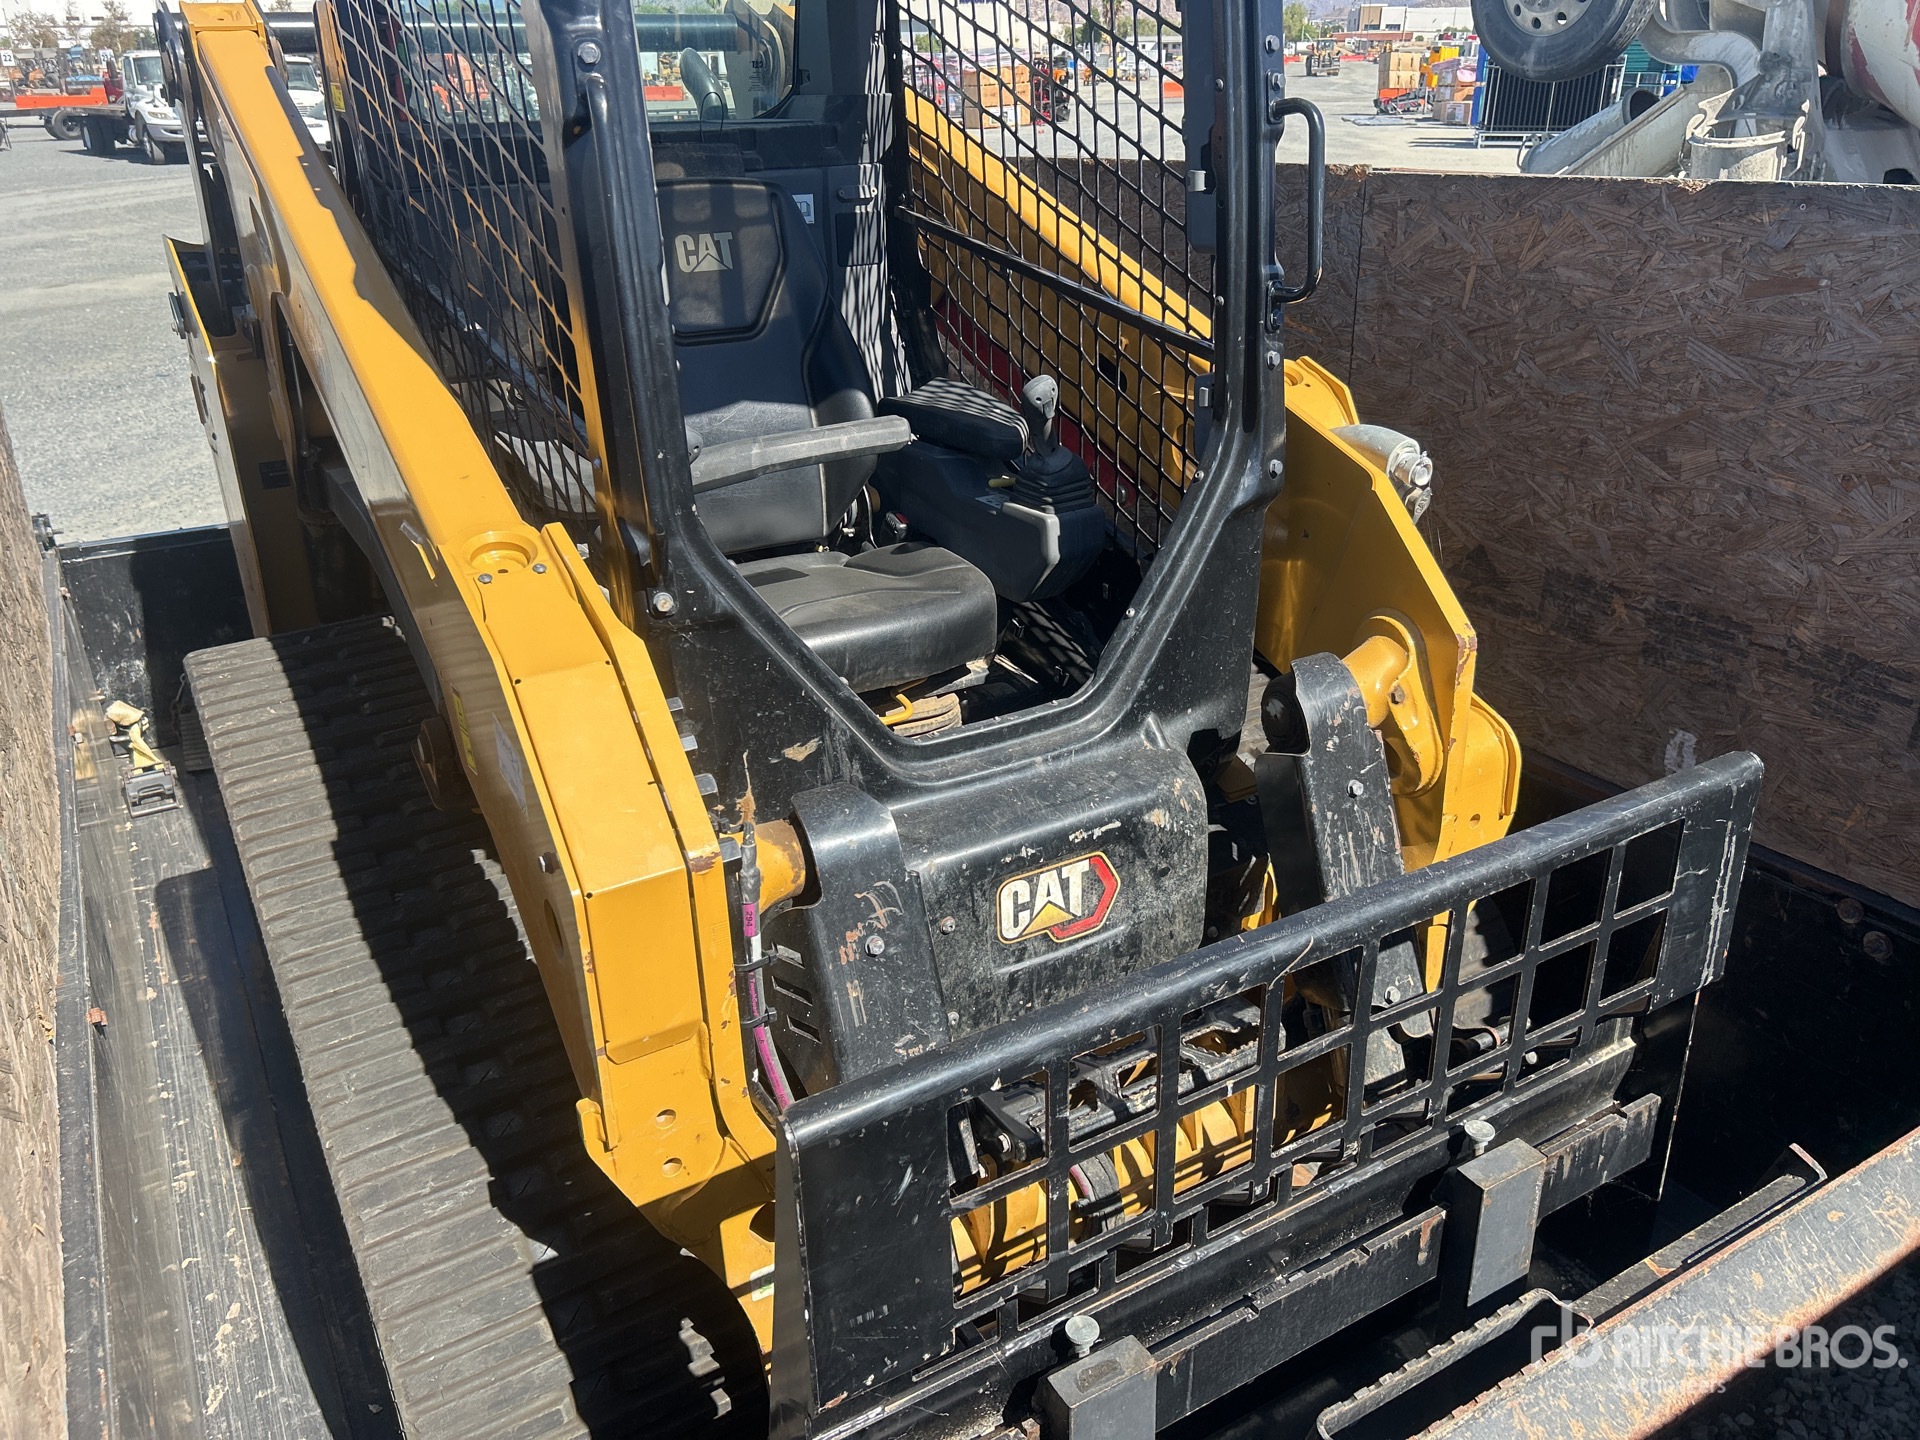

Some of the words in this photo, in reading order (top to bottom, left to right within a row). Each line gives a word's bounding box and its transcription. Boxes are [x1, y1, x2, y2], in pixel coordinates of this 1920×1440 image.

[2, 54, 12, 62] 22
[675, 231, 734, 273] CAT
[1000, 859, 1090, 939] CAT
